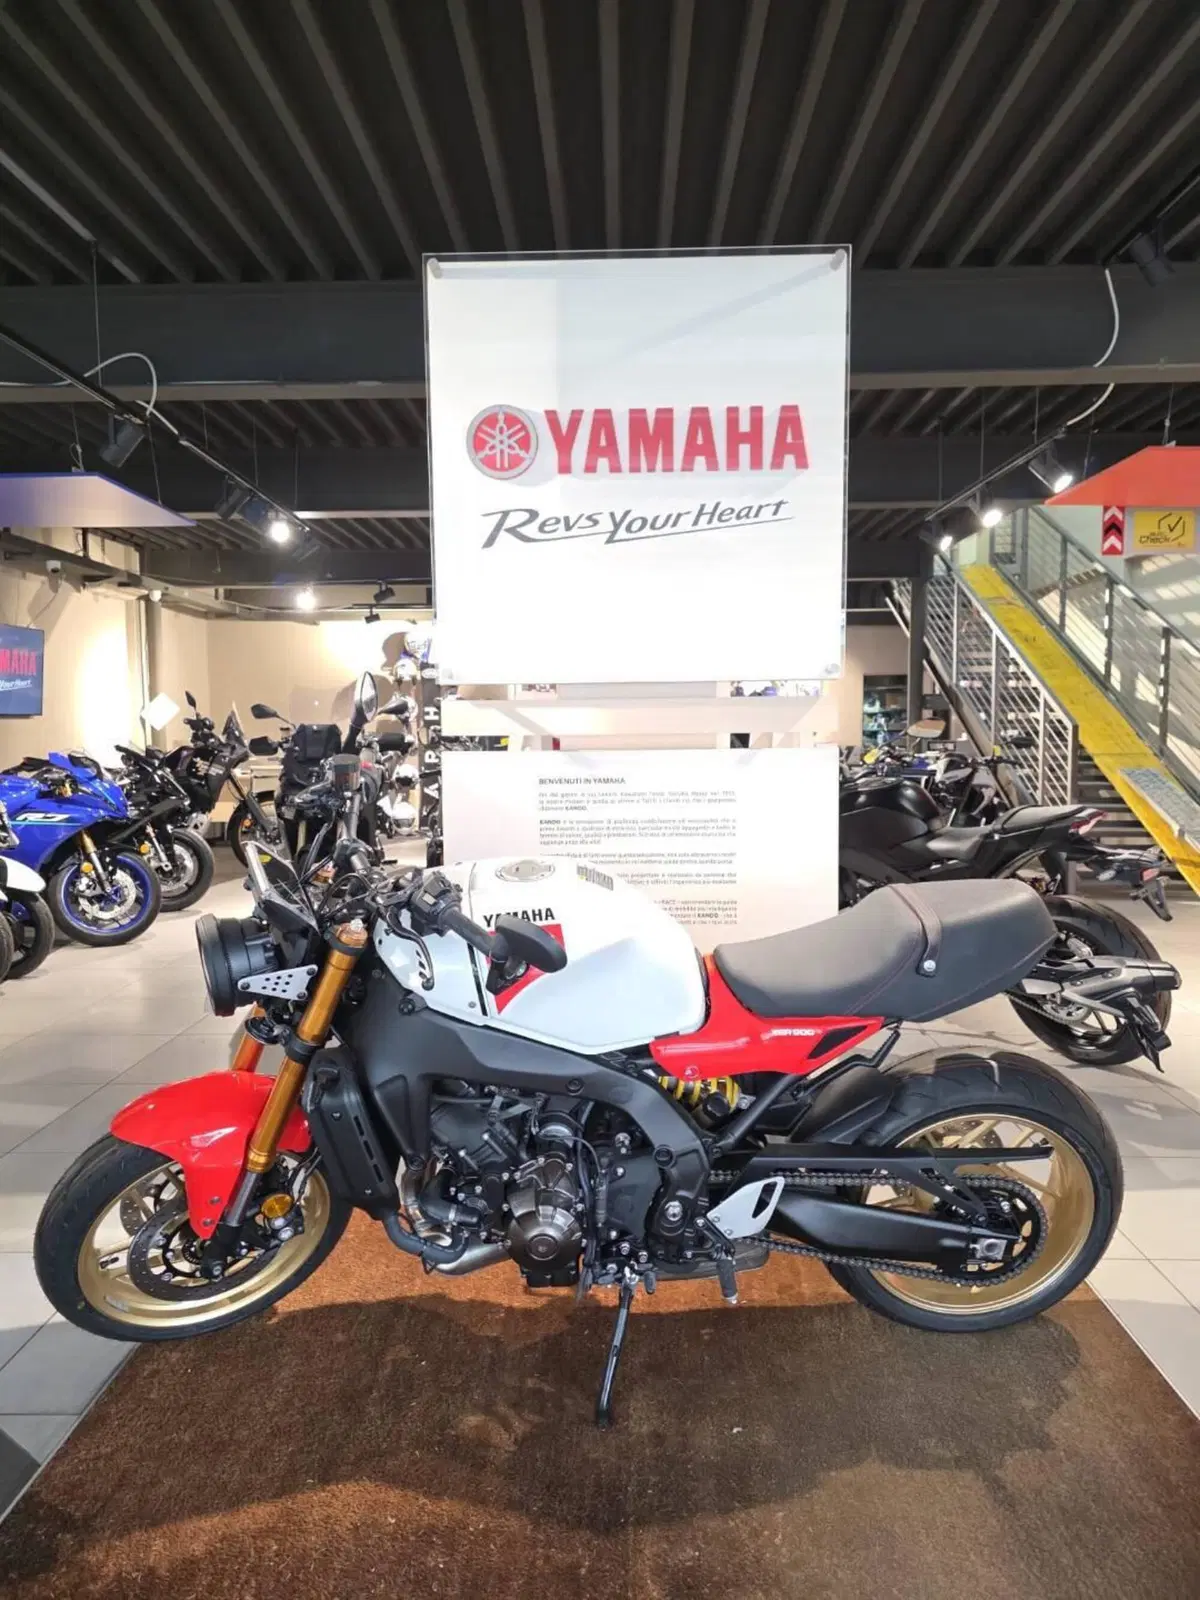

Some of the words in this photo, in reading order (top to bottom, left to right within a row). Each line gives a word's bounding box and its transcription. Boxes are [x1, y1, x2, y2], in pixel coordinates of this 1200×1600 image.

[543, 404, 809, 475] YAMAHA
[480, 507, 603, 549] Revs
[604, 507, 692, 545] Your
[691, 498, 791, 527] Heart
[0, 648, 37, 676] MAHA
[538, 777, 582, 785] BENVENUTI
[583, 777, 592, 785] IN
[593, 776, 626, 785] YAMAHA
